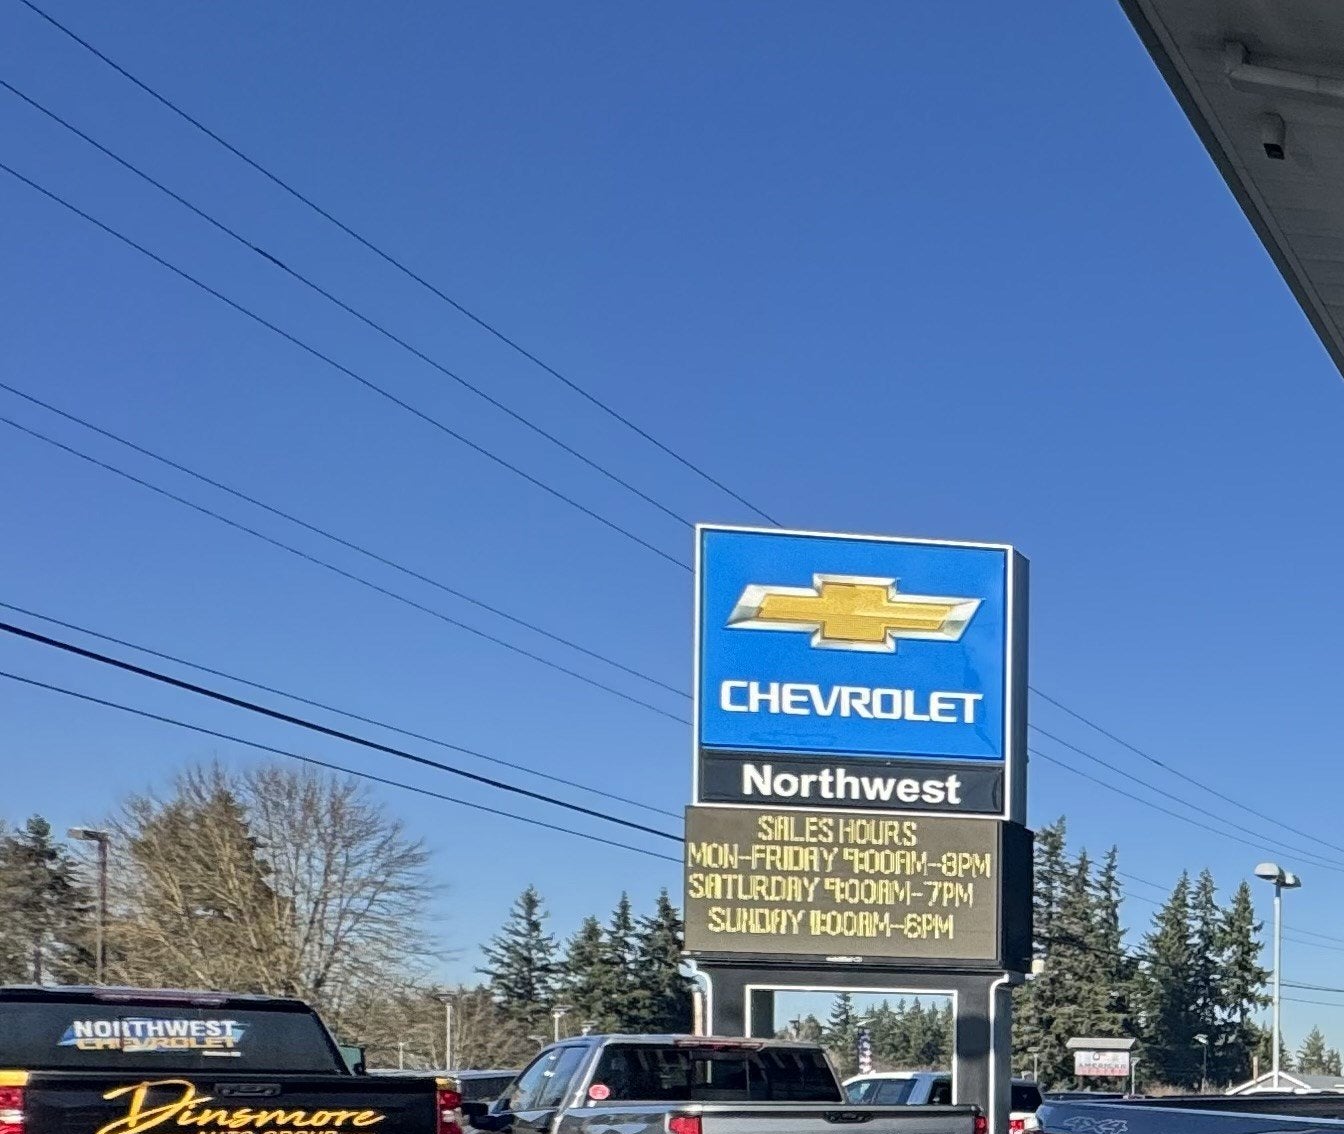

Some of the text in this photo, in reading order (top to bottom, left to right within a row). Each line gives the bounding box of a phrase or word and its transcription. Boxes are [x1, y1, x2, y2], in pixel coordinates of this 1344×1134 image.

[721, 680, 984, 724] CHEVROLET
[742, 764, 961, 804] Northwest
[757, 814, 917, 847] SALES HOURS
[688, 842, 991, 878] MON-FRIDAY 9:00AM-8PM
[688, 873, 820, 902] SATURDAY
[708, 906, 804, 935] SUNDAY
[73, 1020, 238, 1037] NORTHWEST
